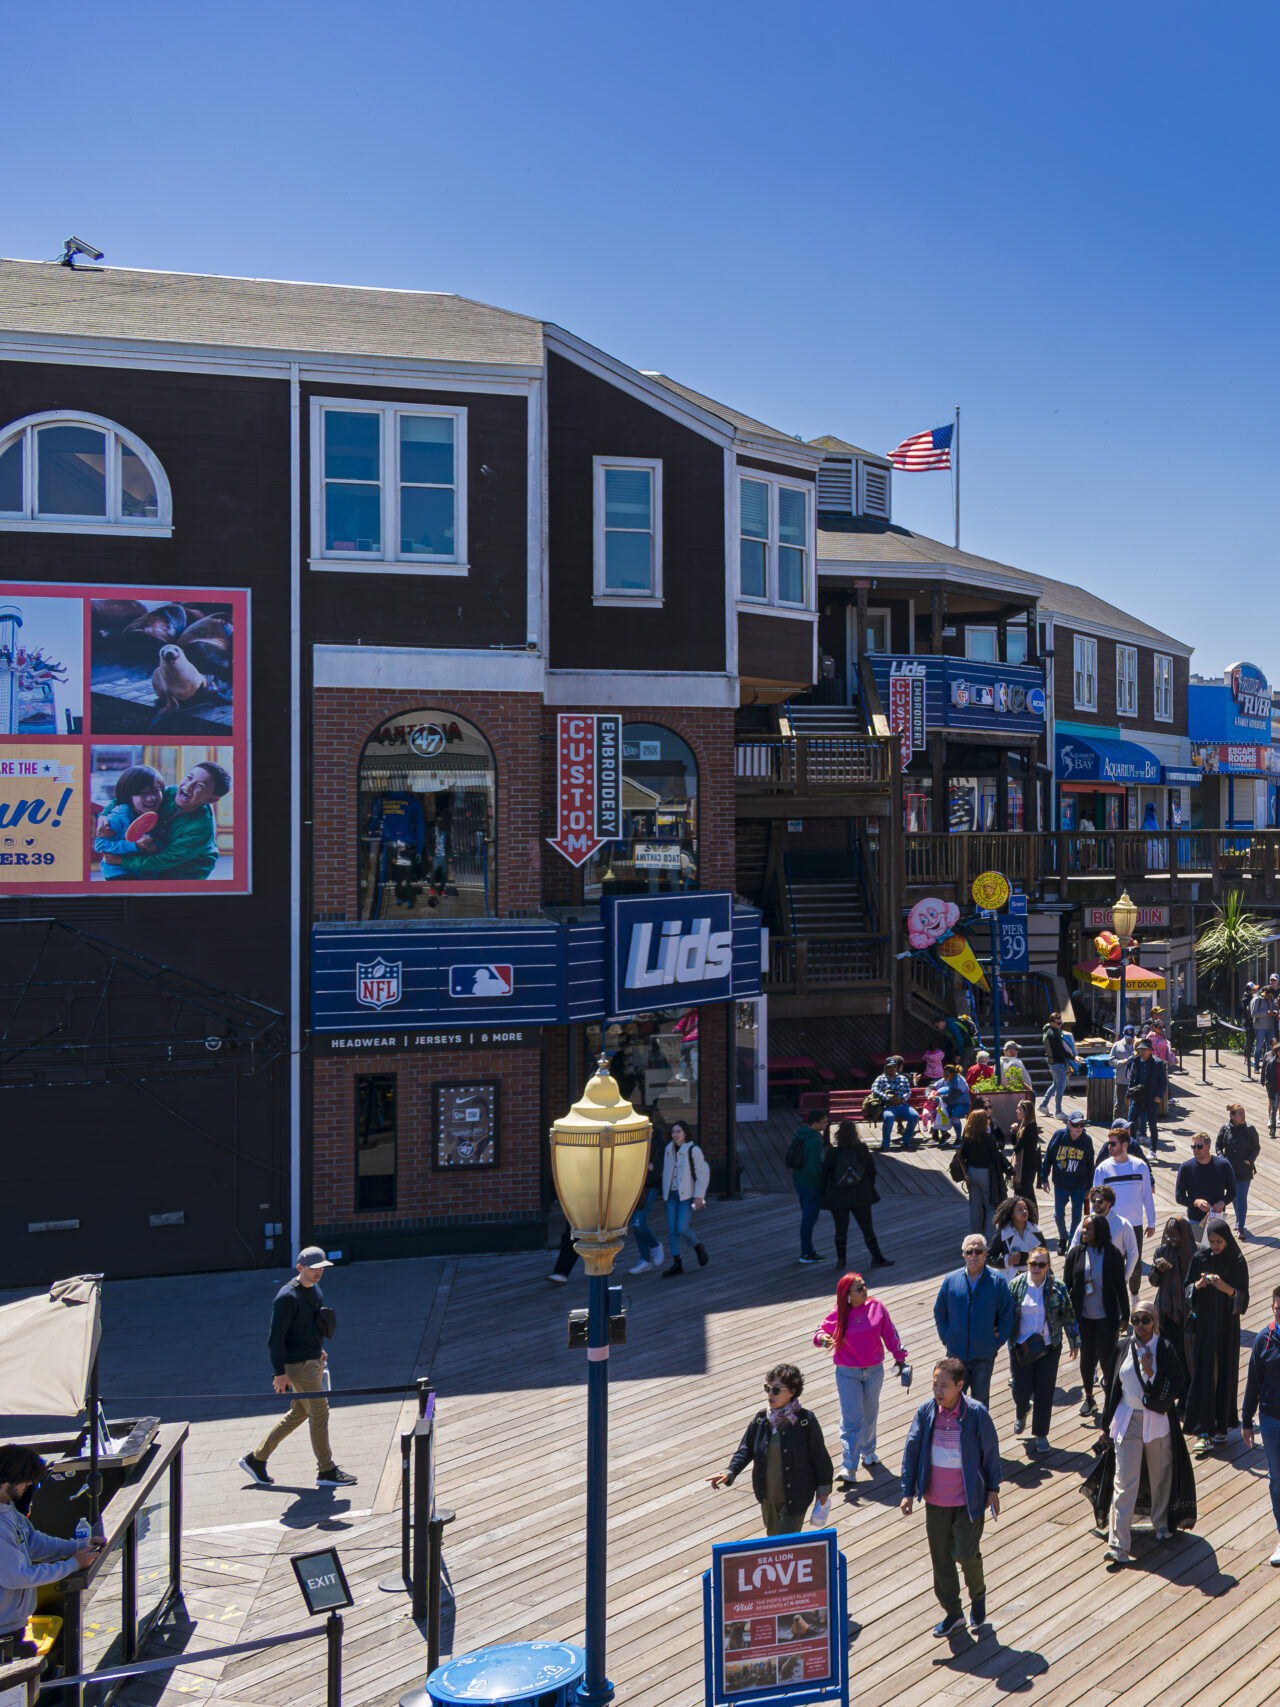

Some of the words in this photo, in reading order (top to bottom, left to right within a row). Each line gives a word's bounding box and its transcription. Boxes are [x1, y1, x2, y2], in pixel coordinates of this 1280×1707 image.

[890, 661, 927, 677] Lids
[957, 690, 969, 703] NFL
[913, 681, 922, 746] EMBROIDERY
[1244, 694, 1271, 717] FLYER
[414, 729, 441, 752] 47
[1228, 747, 1257, 755] ESCAPE
[1228, 755, 1257, 763] ROOMS
[18, 762, 39, 774] THE
[1075, 760, 1094, 769] BAY
[1103, 757, 1135, 782] AQUARIUM
[1145, 761, 1157, 778] BAY
[601, 722, 615, 832] EMBROIDERY
[1170, 772, 1186, 781] VIRTUAL
[567, 719, 587, 853] CUSTOM
[986, 896, 1006, 909] CREAM
[1092, 908, 1163, 926] BODIN
[1002, 925, 1024, 935] PIER
[624, 918, 733, 989] Lids
[1003, 936, 1026, 960] 39
[362, 980, 396, 1002] NFL
[331, 1037, 396, 1048] HEADWEAR
[414, 1035, 462, 1045] JERSEYS
[481, 1034, 488, 1042] &
[493, 1033, 523, 1042] MORE
[1056, 1145, 1068, 1161] LAS
[1066, 1159, 1080, 1172] NV
[757, 1556, 773, 1565] SEA
[774, 1553, 794, 1562] LION
[306, 1573, 337, 1590] EXIT
[738, 1559, 813, 1592] LOVE
[796, 1592, 817, 1600] PLAYFUL
